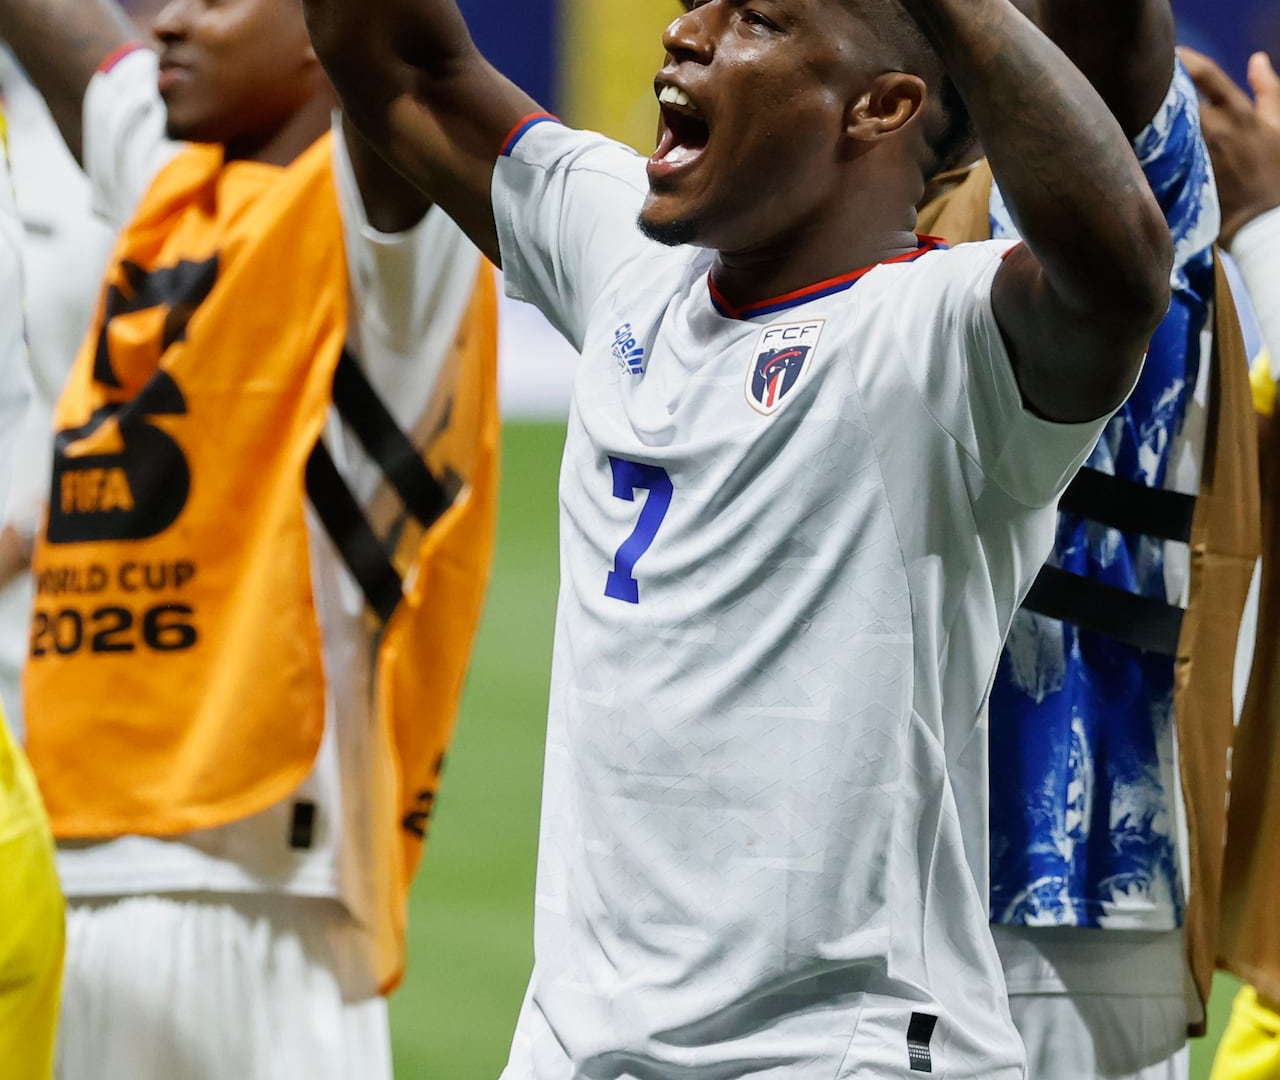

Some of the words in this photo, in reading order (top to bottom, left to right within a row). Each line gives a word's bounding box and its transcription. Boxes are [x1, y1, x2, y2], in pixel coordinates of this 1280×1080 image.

[763, 325, 818, 344] FCF
[60, 467, 135, 515] FIFA
[604, 455, 674, 604] 7
[118, 561, 197, 591] CUP
[33, 602, 198, 656] 2026
